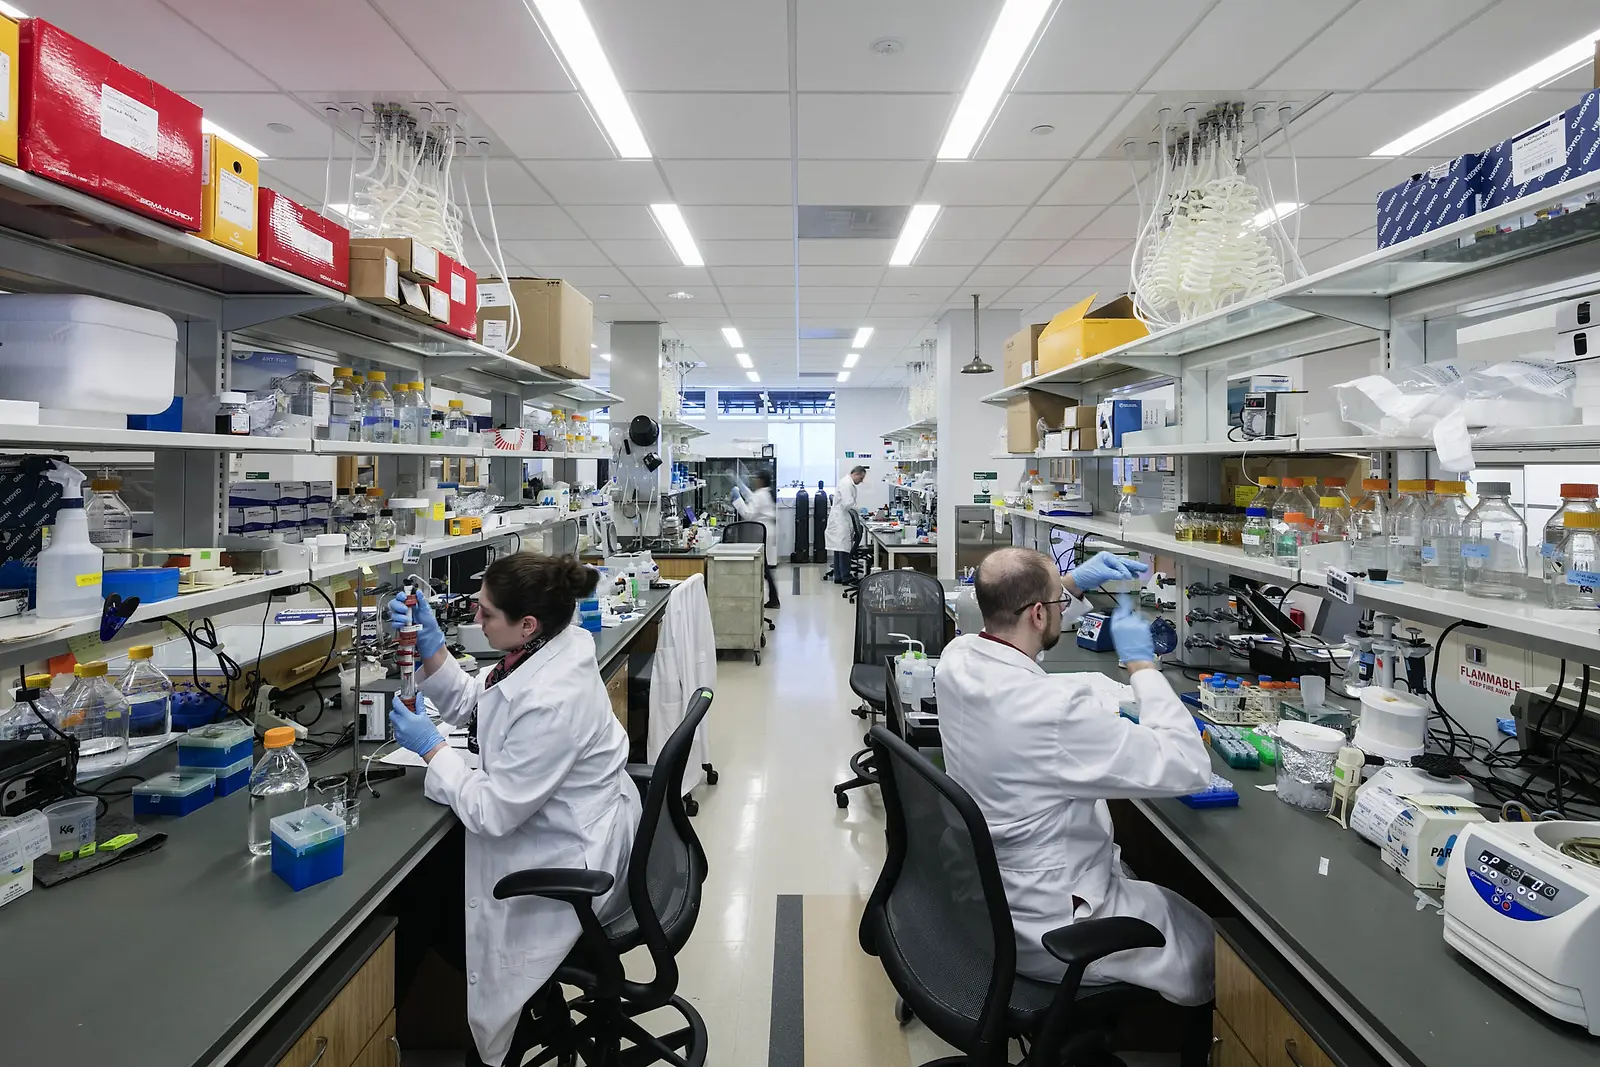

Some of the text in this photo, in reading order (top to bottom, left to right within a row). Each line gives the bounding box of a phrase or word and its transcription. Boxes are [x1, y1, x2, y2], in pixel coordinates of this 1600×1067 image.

[1489, 157, 1504, 181] QIAGEN
[1412, 185, 1427, 206] QIAGEN
[1443, 176, 1459, 199] QIAGEN
[1456, 187, 1475, 209] QIAGEN
[1481, 185, 1497, 209] QIAGEN
[140, 197, 193, 222] SIGMA-ALDRICH
[1385, 192, 1398, 213] QIAGEN
[1395, 201, 1408, 222] QIAGEN
[1424, 194, 1438, 216] QIAGEN
[1406, 210, 1420, 231] QIAGEN
[1436, 203, 1452, 225] QIAGEN
[1379, 216, 1392, 236] QIAGEN
[2, 487, 22, 506] QIAGEN
[42, 491, 59, 509] QIAGEN
[5, 532, 23, 551] QIAGEN
[1460, 665, 1521, 692] FLAMMABLE
[1468, 680, 1511, 697] KEEP FIRE AWAY
[59, 825, 75, 835] KG
